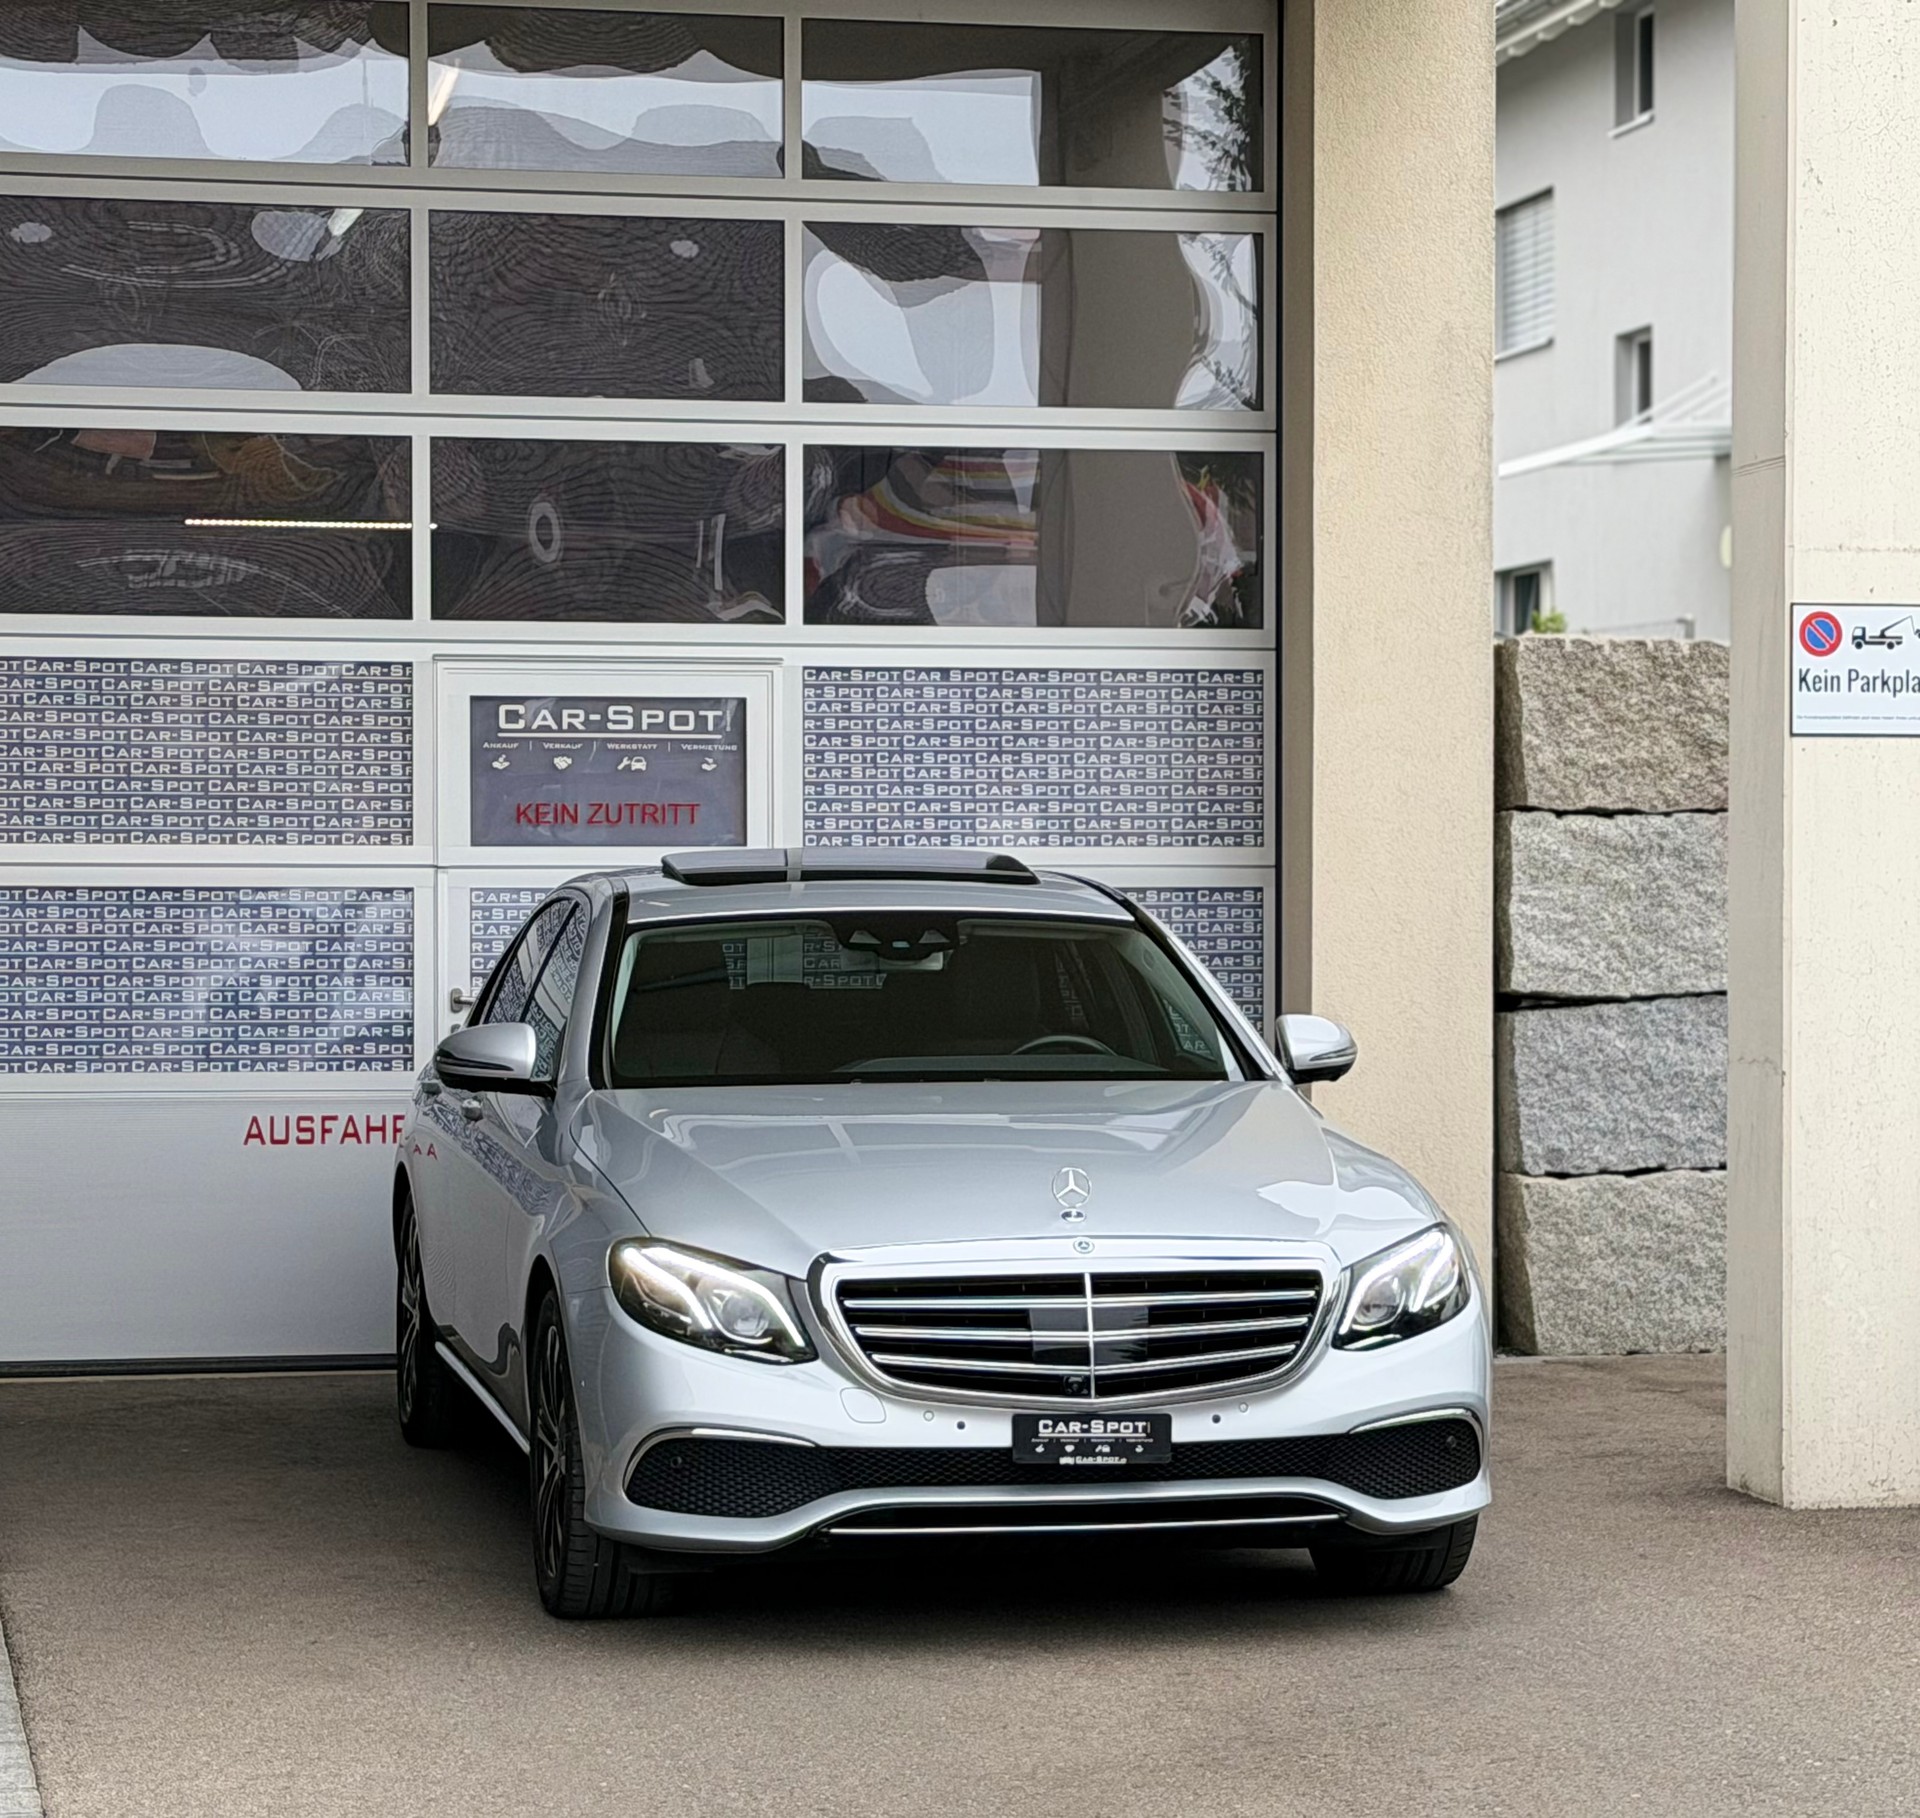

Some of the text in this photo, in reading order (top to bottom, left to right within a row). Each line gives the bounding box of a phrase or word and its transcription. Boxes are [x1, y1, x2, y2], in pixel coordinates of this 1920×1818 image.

[23, 660, 128, 672] CAR-SPOT
[130, 662, 234, 674] CAR-SPOT
[237, 663, 339, 675] CAR-SPOT
[804, 669, 1195, 683] CAR-SPOT CAR-SPOT CAR-SPOT
[1798, 667, 1920, 698] Kein Parkpla
[101, 679, 205, 691] CAR-SPOT
[208, 680, 311, 692] CAR-SPOT
[876, 686, 973, 698] CAR-SPOT
[975, 687, 1071, 699] CAR-SPOT
[1073, 687, 1169, 699] CAR-SPOT
[23, 693, 128, 705] CAR-SPOT
[130, 695, 234, 707] CAR-SPOT
[237, 696, 339, 708] CAR-SPOT
[804, 701, 1195, 714] CAR-SPOT CAR-SPOT CAR-SPOT CAR-SPOT
[101, 712, 205, 724] CAR-SPOT
[208, 713, 311, 725] CAR-SPOT
[499, 704, 723, 731] CAR-SPOT
[876, 718, 973, 730] CAR-SPOT
[975, 719, 1071, 731] CAR-SPOT
[23, 728, 128, 740] CAR-SPOT
[130, 730, 234, 742] CAR-SPOT
[237, 731, 339, 743] CAR-SPOT
[804, 735, 901, 747] CAR-SPOT
[903, 735, 999, 747] CAR-SPOT
[1002, 735, 1098, 747] CAR-SPOT
[1100, 736, 1195, 748] CAR-SPOT
[607, 742, 658, 750] WERKSTATT
[681, 743, 738, 751] VERMIETUNG
[101, 747, 205, 759] CAR-SPOT
[208, 748, 311, 760] CAR-SPOT
[876, 752, 973, 764] CAR-SPOT
[975, 752, 1071, 764] CAR-SPOT
[1073, 752, 1169, 764] CAR-SPOT
[23, 761, 128, 773] CAR-SPOT
[130, 762, 234, 774] CAR-SPOT
[237, 763, 339, 775] CAR-SPOT
[804, 767, 1195, 779] CAR-SPOT CAR-SPOT CAR-SPOT CAR-SPOT
[101, 779, 205, 791] CAR-SPOT
[208, 780, 311, 792] CAR-SPOT
[876, 783, 973, 795] CAR-SPOT
[975, 784, 1071, 796] CAR-SPOT
[1073, 784, 1169, 796] CAR-SPOT
[23, 797, 128, 809] CAR-SPOT
[130, 798, 234, 810] CAR-SPOT
[237, 798, 339, 810] CAR-SPOT
[804, 801, 1195, 813] CAR-SPOT CAR-SPOT CAR-SPOT CAR-SPOT
[516, 803, 701, 825] KEIN ZUTRITT
[101, 815, 205, 827] CAR-SPOT
[208, 815, 311, 827] CAR-SPOT
[876, 817, 973, 829] CAR-SPOT
[975, 817, 1071, 829] CAR-SPOT
[1073, 817, 1169, 829] CAR-SPOT
[23, 831, 128, 843] CAR-SPOT
[130, 831, 234, 843] CAR-SPOT
[237, 831, 339, 843] CAR-SPOT
[804, 834, 1195, 846] CAR-SPOT CAR-SPOT CAR-SPOT CAR-SPOT
[25, 889, 130, 901] CAR-SPOT
[132, 890, 236, 902] CAR-SPOT
[238, 889, 342, 901] CAR-SPOT
[102, 907, 207, 919] CAR-SPOT
[210, 906, 313, 918] CAR-SPOT
[25, 922, 130, 934] CAR-SPOT
[132, 922, 236, 934] CAR-SPOT
[238, 922, 342, 934] CAR-SPOT
[102, 940, 207, 952] CAR-SPOT
[210, 940, 313, 952] CAR-SPOT
[25, 957, 130, 969] CAR-SPOT
[132, 957, 236, 969] CAR-SPOT
[238, 957, 342, 969] CAR-SPOT
[102, 975, 207, 987] CAR-SPOT
[210, 975, 313, 987] CAR-SPOT
[25, 991, 130, 1003] CAR-SPOT
[132, 990, 236, 1002] CAR-SPOT
[238, 990, 342, 1002] CAR-SPOT
[102, 1008, 207, 1020] CAR-SPOT
[210, 1008, 313, 1020] CAR-SPOT
[25, 1026, 130, 1038] CAR-SPOT
[132, 1026, 236, 1038] CAR-SPOT
[238, 1025, 342, 1037] CAR-SPOT
[102, 1043, 207, 1055] CAR-SPOT
[210, 1043, 313, 1055] CAR-SPOT
[25, 1060, 130, 1072] CAR-SPOT
[132, 1060, 236, 1072] CAR-SPOT
[238, 1059, 342, 1072] CAR-SPOT
[1038, 1419, 1147, 1434] CAR-SPOT
